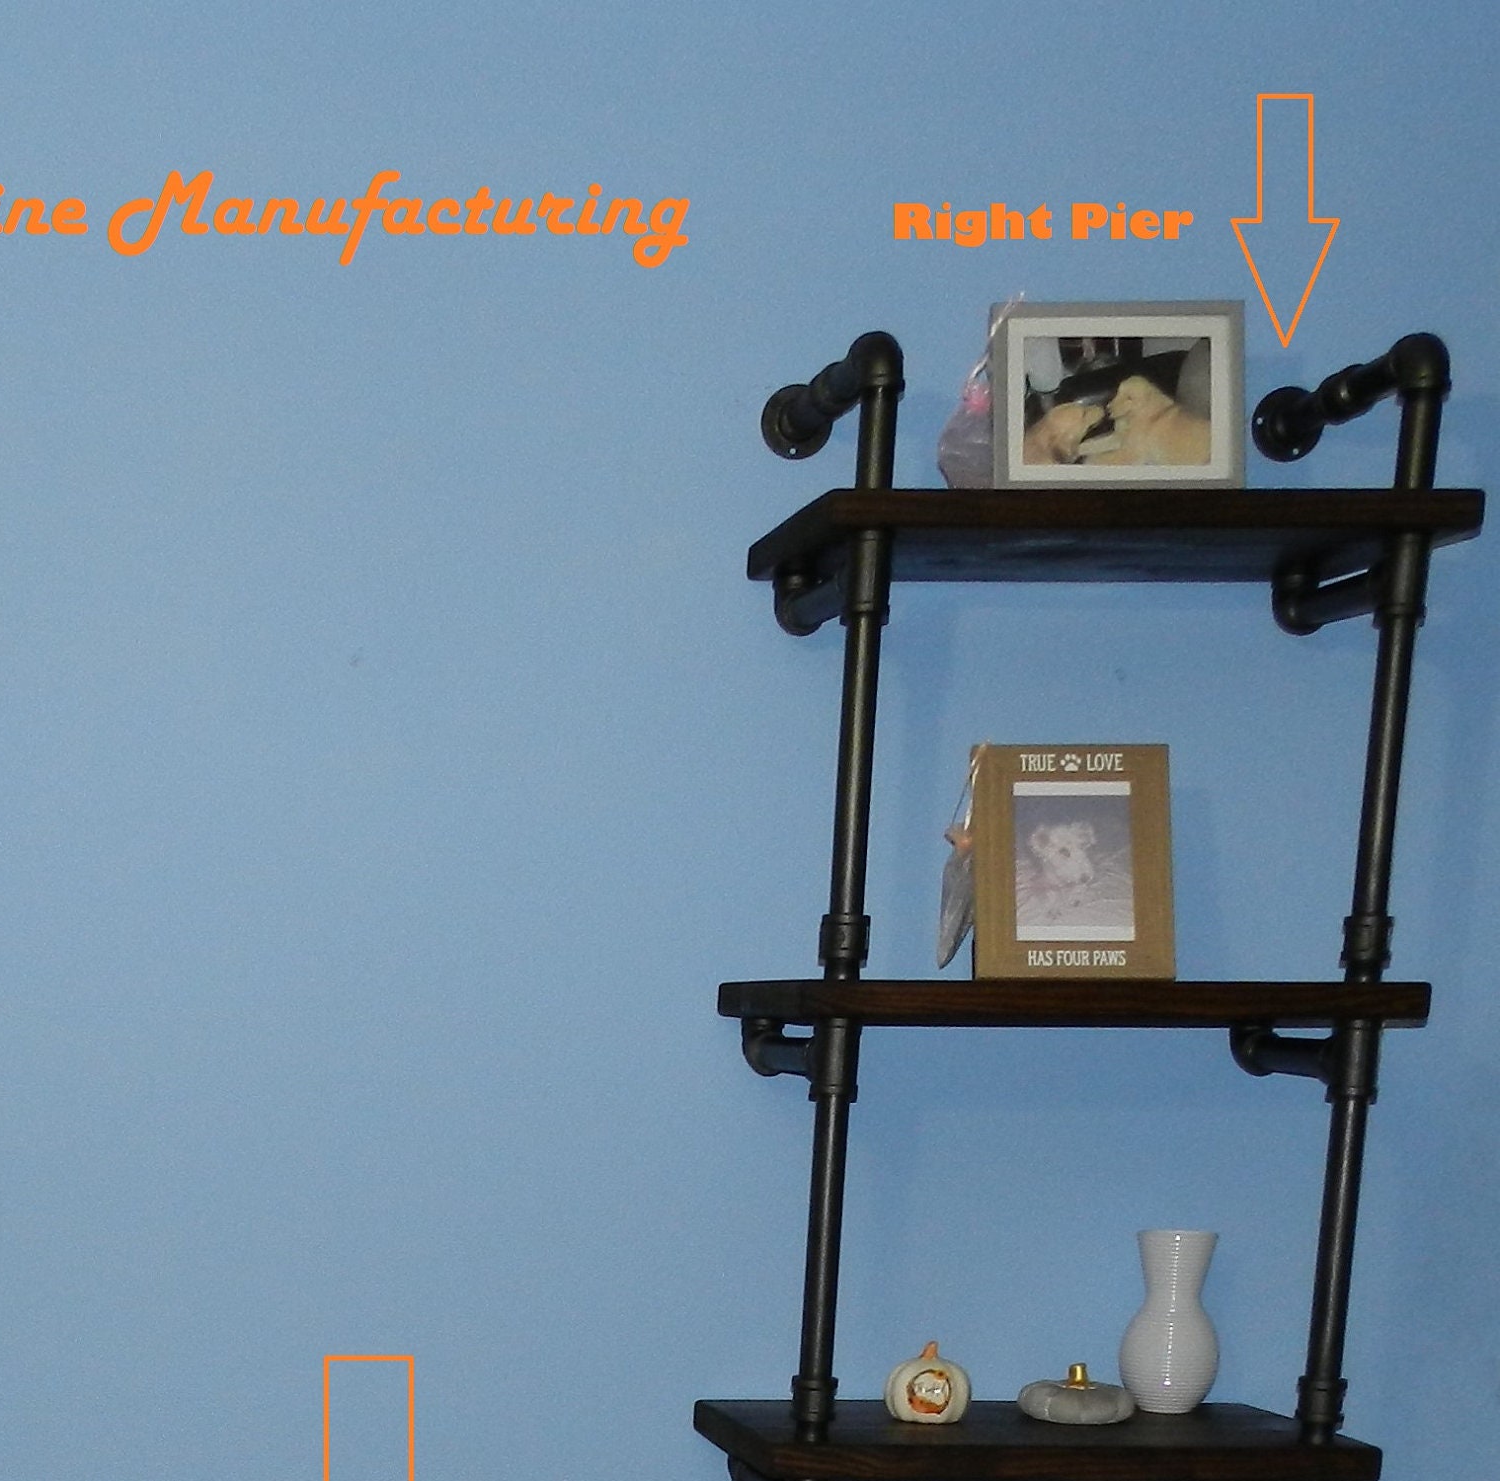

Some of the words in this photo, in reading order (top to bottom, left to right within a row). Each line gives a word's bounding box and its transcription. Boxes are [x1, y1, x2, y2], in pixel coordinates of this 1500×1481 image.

[1020, 753, 1056, 772] TRUE
[1086, 753, 1124, 772] LOVE
[1027, 950, 1053, 966] HAS
[1056, 950, 1090, 966] FOUR
[1093, 950, 1126, 966] PAWS
